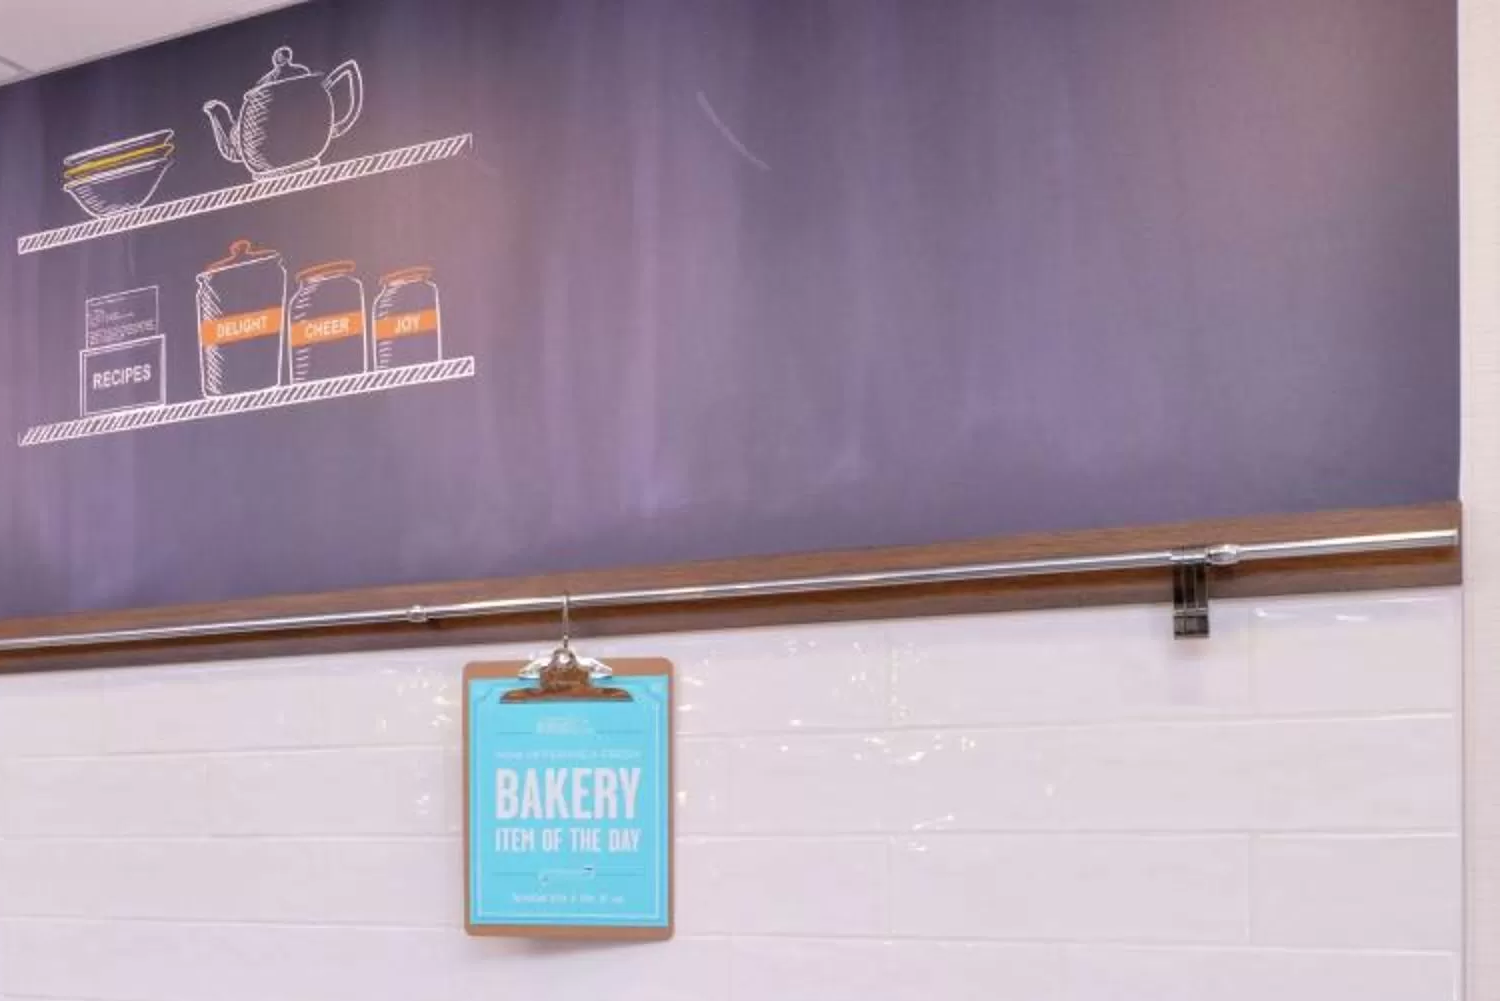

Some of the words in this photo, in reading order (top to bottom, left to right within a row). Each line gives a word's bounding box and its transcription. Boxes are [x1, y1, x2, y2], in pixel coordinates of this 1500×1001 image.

[216, 315, 269, 338] DELIGHT
[304, 317, 351, 337] CHEER
[394, 315, 422, 333] JOY
[92, 363, 153, 389] RECIPES
[495, 767, 642, 820] BAKERY
[495, 827, 535, 853] ITEM
[542, 827, 564, 853] OF
[569, 827, 601, 853] THE
[608, 827, 642, 853] DAY
